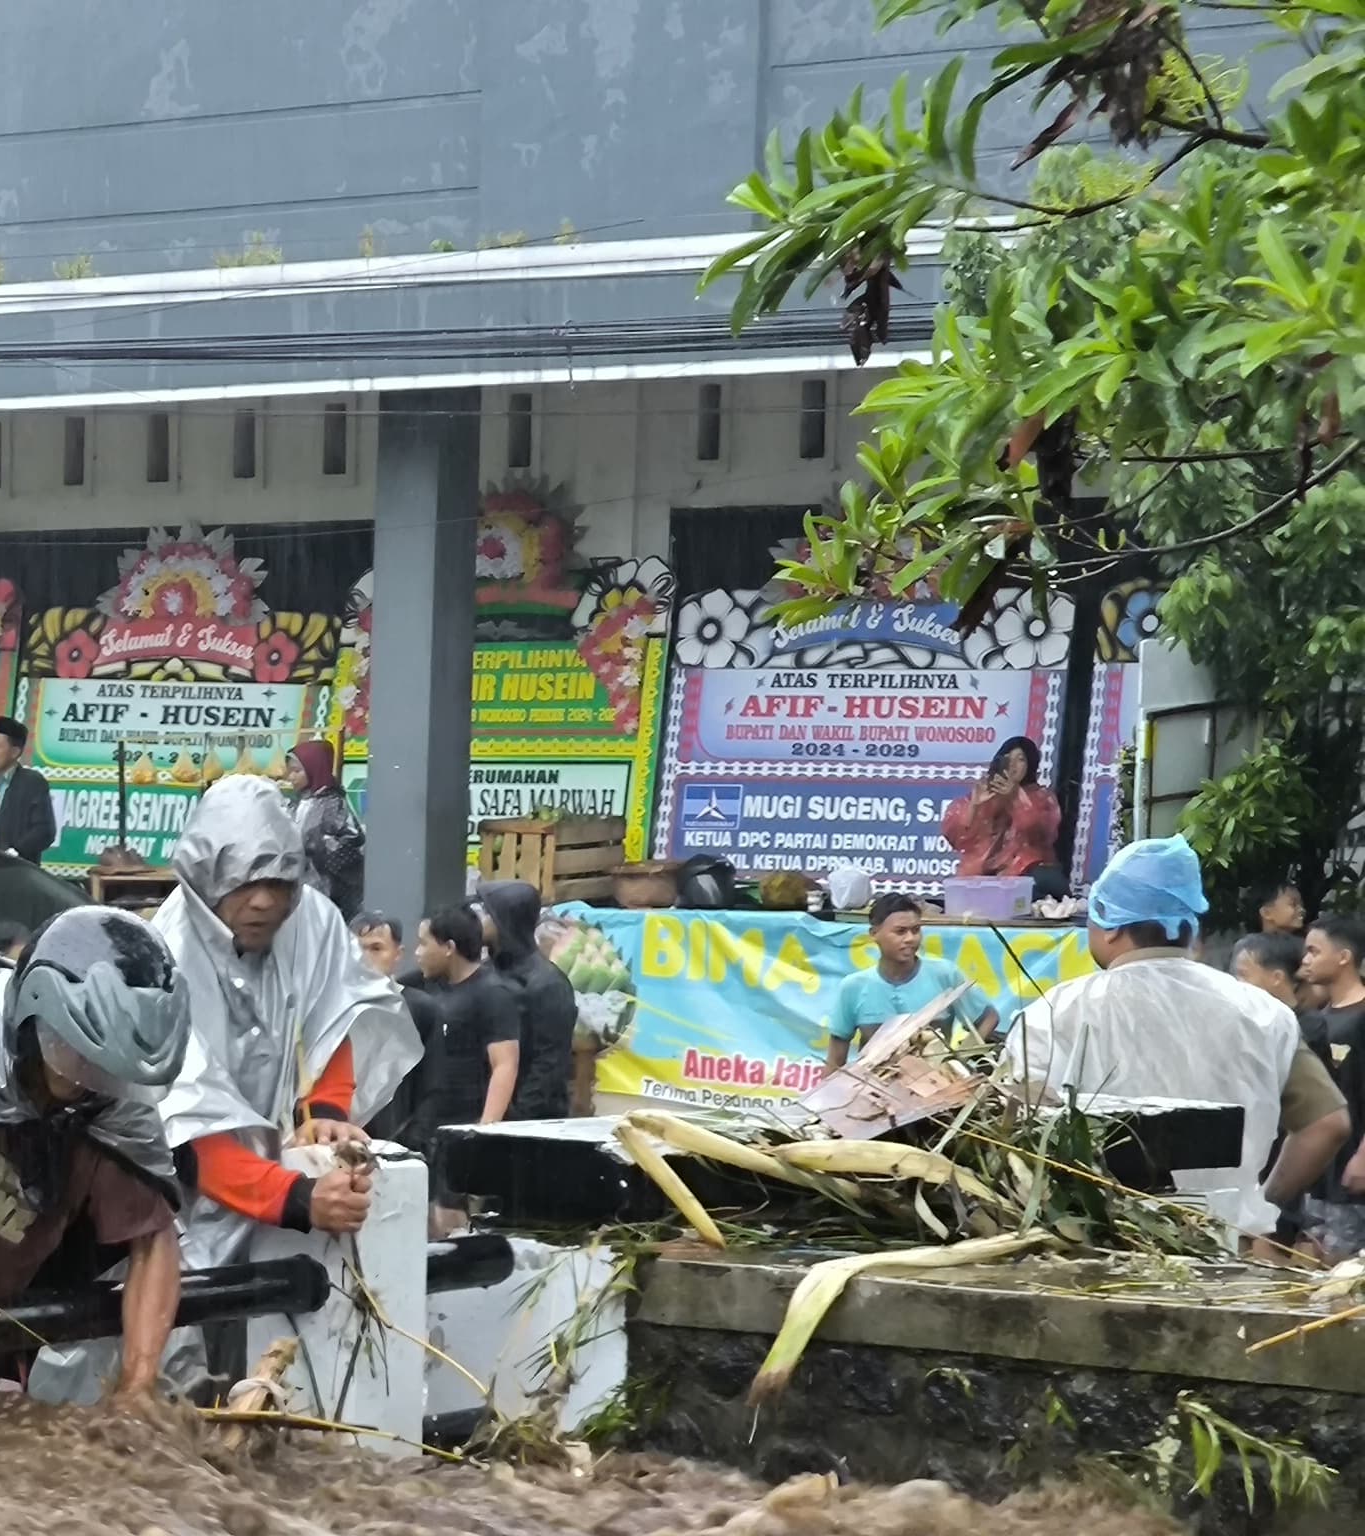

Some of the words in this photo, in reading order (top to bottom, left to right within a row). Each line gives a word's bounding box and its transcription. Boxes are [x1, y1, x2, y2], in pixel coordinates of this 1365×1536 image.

[866, 602, 884, 629] &
[891, 603, 962, 645] Sukses
[99, 622, 172, 657] Selamat
[177, 622, 192, 647] &
[197, 624, 255, 661] Sukses
[472, 649, 587, 670] ERPILIHNYA
[97, 683, 135, 698] ATAS
[140, 685, 244, 701] TERPILIHNYA
[500, 672, 596, 702] HUSEIN
[771, 672, 818, 689] ATAS
[827, 673, 959, 690] TERPILIHNYA
[62, 703, 130, 723] AFIF
[160, 705, 276, 728] HUSEIN
[739, 694, 824, 718] AFIF
[843, 695, 988, 720] HUSEIN
[726, 724, 774, 741] BUPATI
[779, 724, 807, 741] DAN
[812, 724, 854, 741] WAKIL
[859, 725, 910, 742] BUPATI
[915, 725, 996, 743] WONOSOBO
[791, 742, 846, 757] 2024
[864, 743, 920, 758] 2029
[469, 769, 560, 784] RUMAHAN
[478, 788, 522, 816] SAFA
[529, 788, 616, 817] MARWAH
[743, 795, 802, 820] MUGI
[807, 795, 912, 826] SUGENG,
[684, 831, 732, 848] KETUA
[737, 831, 770, 848] DPC
[774, 832, 827, 849] PARTAI
[831, 834, 918, 852] DEMOKRAT
[752, 853, 802, 871] KETUA
[641, 913, 822, 995] BIMA
[684, 1048, 767, 1085] Aneka
[643, 1078, 697, 1102] Terima
